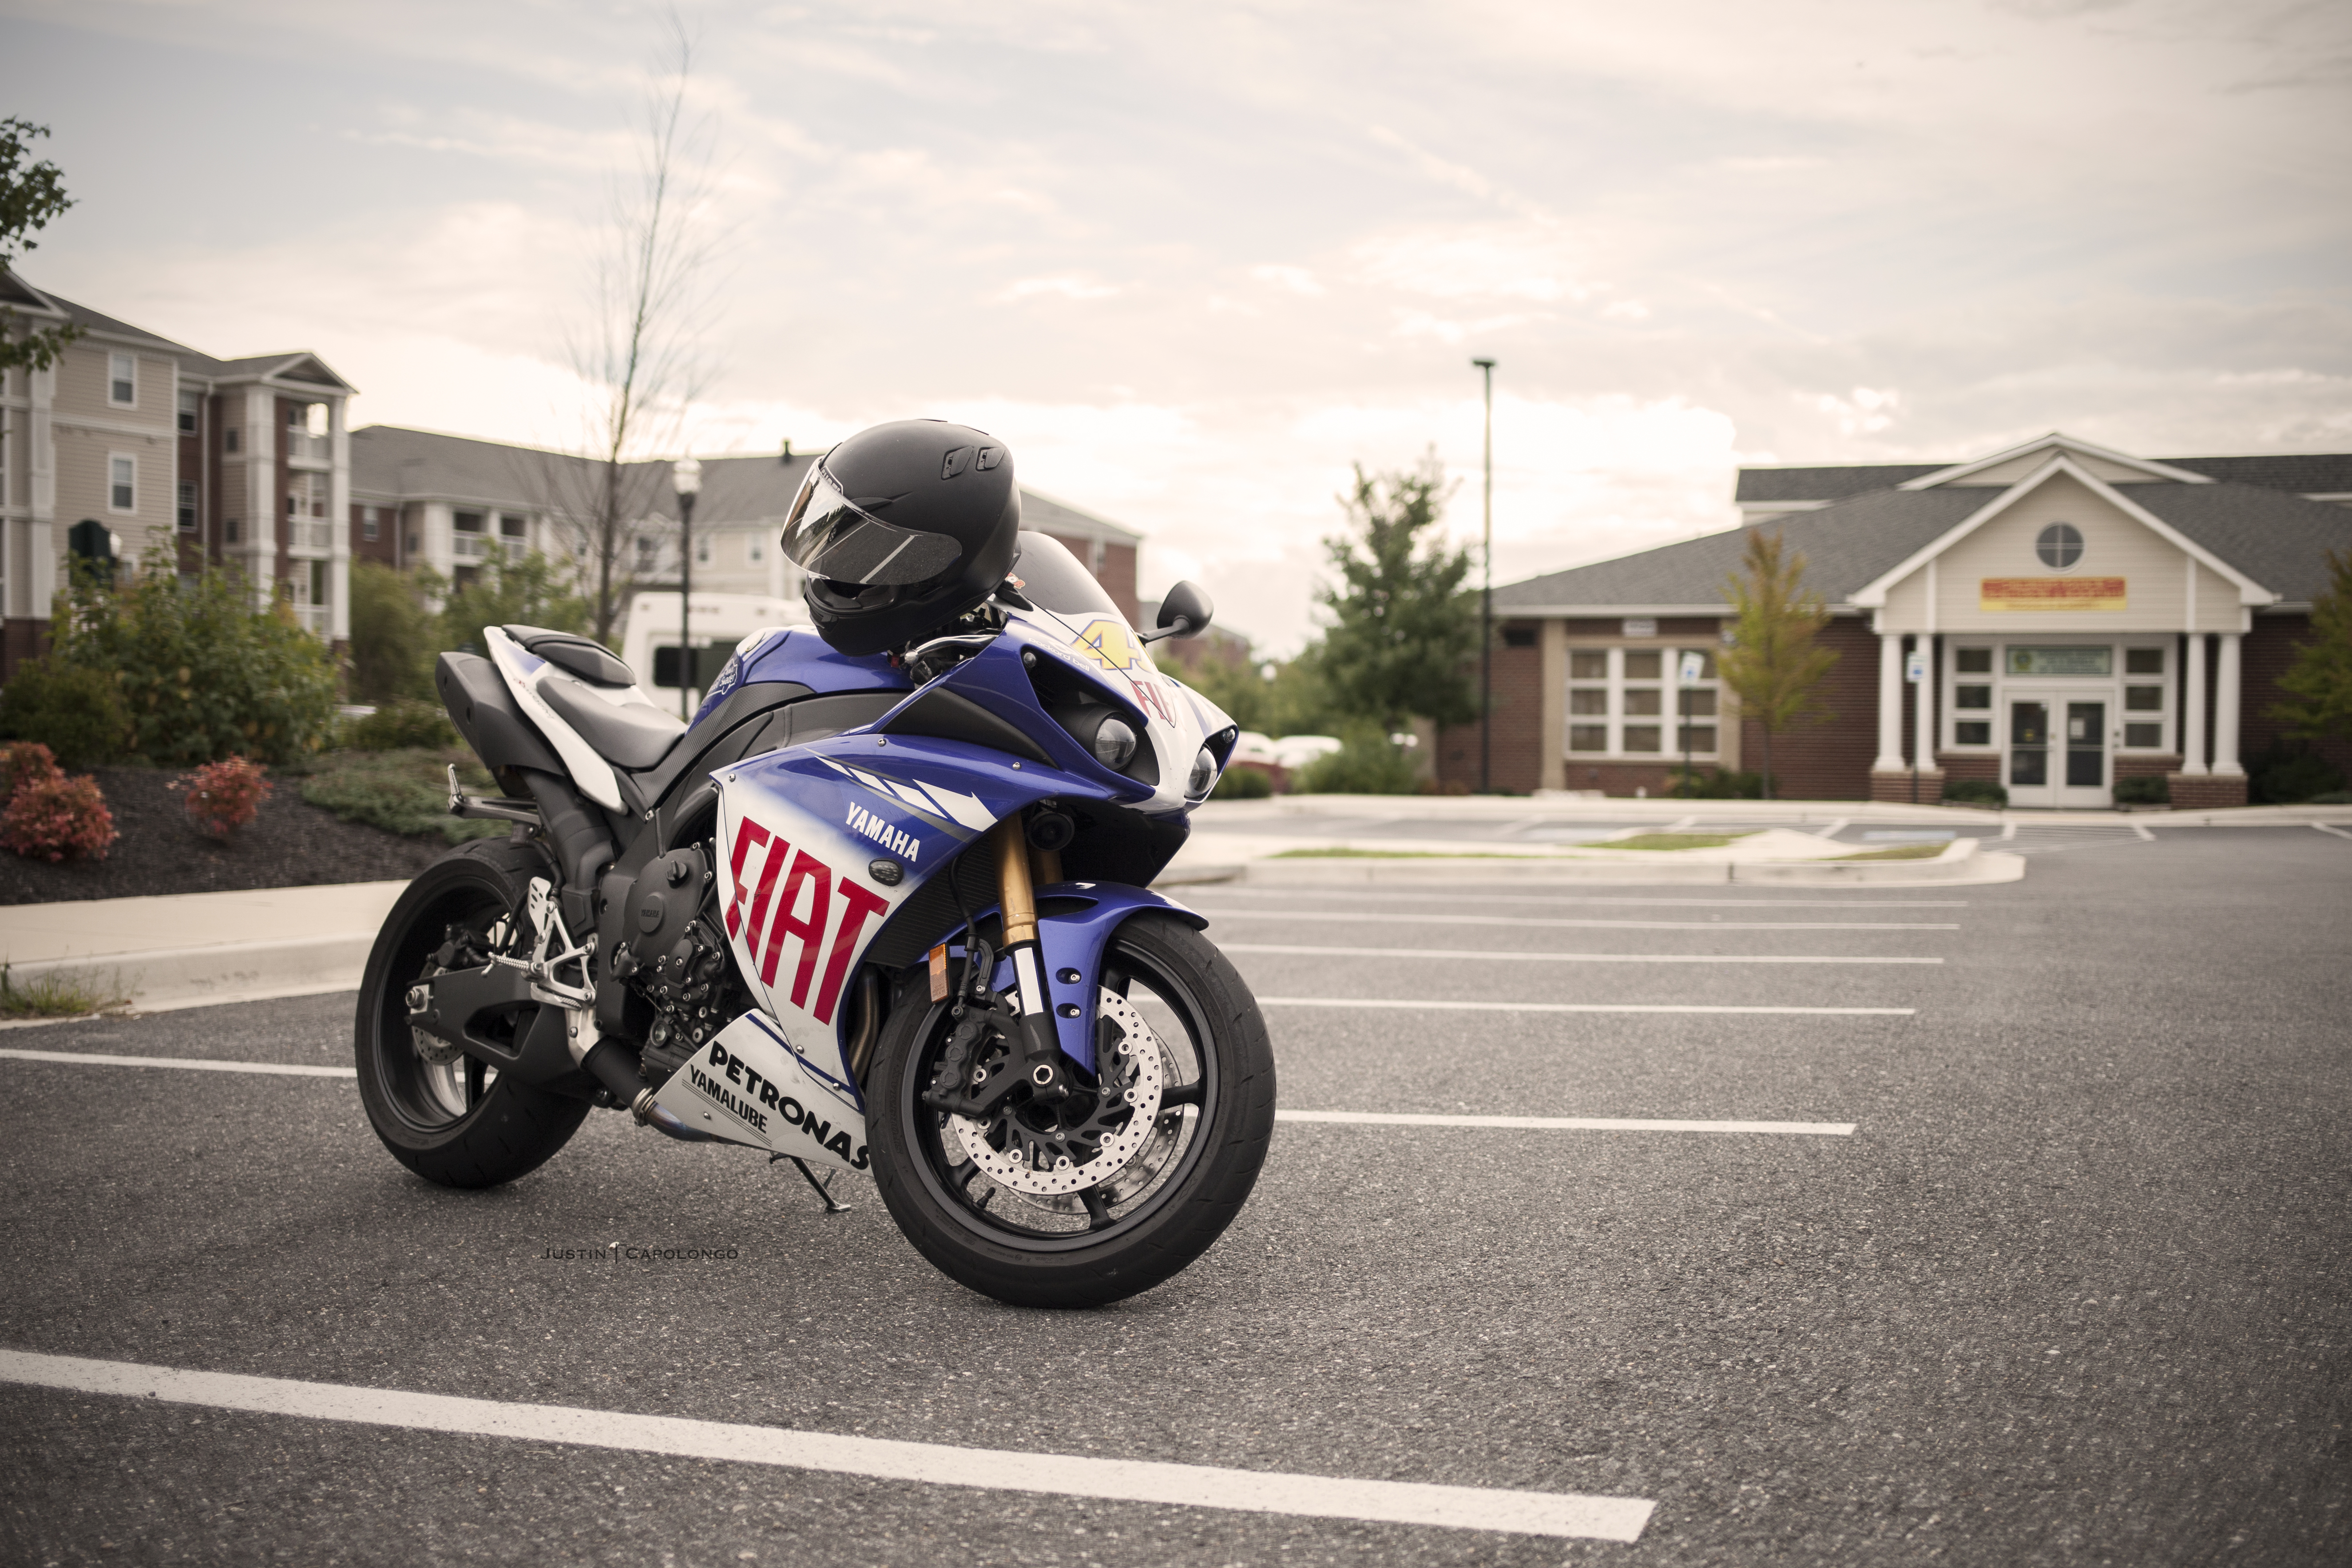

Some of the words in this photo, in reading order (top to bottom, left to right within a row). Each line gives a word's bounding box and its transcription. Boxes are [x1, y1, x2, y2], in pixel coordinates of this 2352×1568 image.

[1028, 638, 1071, 661] packard
[1072, 658, 1090, 672] bell
[845, 801, 920, 862] YAMAHA
[725, 816, 890, 1026] FIAT
[690, 1064, 768, 1134] YAMALUBE
[709, 1040, 869, 1170] PETRONAS
